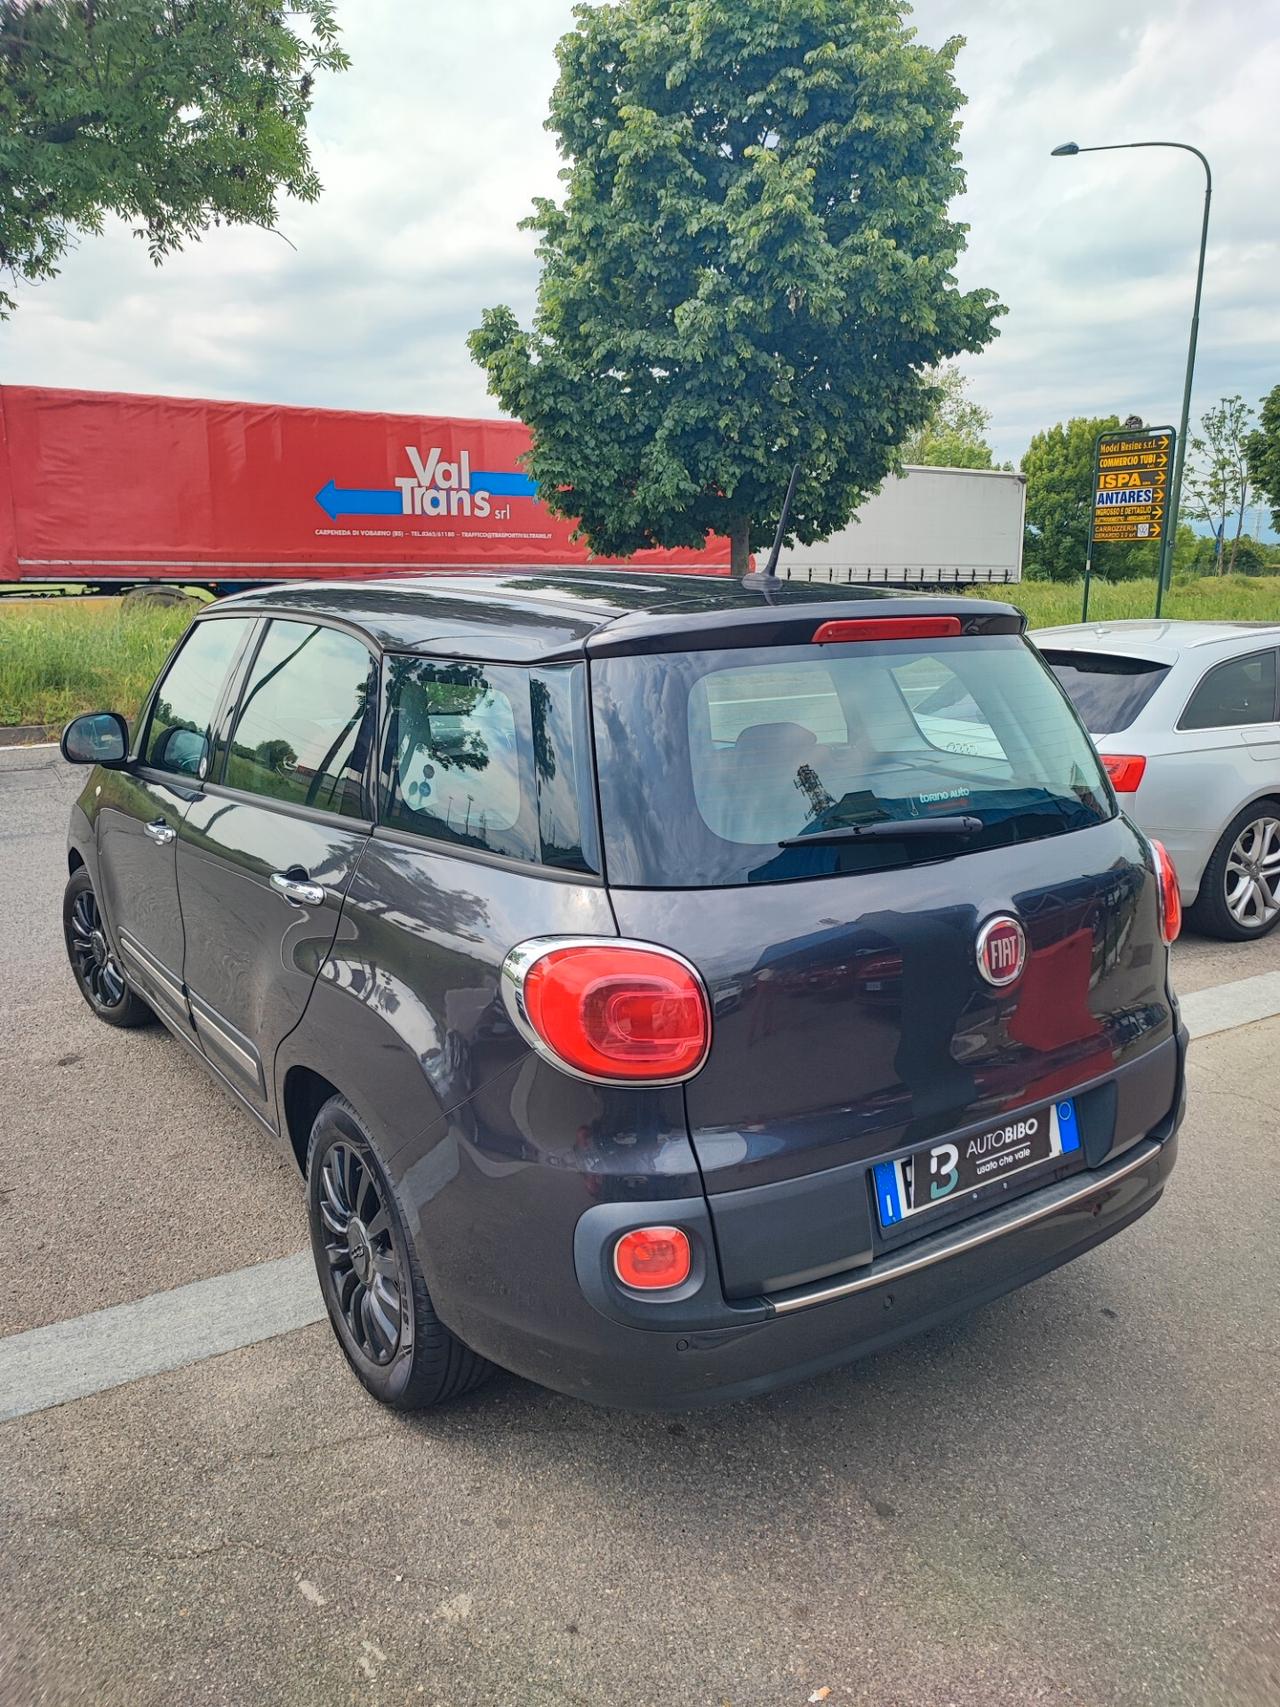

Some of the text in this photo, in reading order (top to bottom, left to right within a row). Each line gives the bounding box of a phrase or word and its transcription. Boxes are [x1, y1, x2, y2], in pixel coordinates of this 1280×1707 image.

[405, 446, 470, 489] Val
[1099, 454, 1156, 468] COMMERCIO TUBI
[1099, 473, 1142, 489] ISPA
[395, 477, 510, 519] Trans srl
[1097, 489, 1152, 505] ANTARES
[1124, 506, 1152, 515] DETTAGLIO
[1094, 525, 1137, 533] CARROZZERIA
[990, 935, 1017, 970] FIAT
[966, 1118, 1038, 1159] AUTOBIBO
[976, 1147, 1031, 1175] usato che vale
